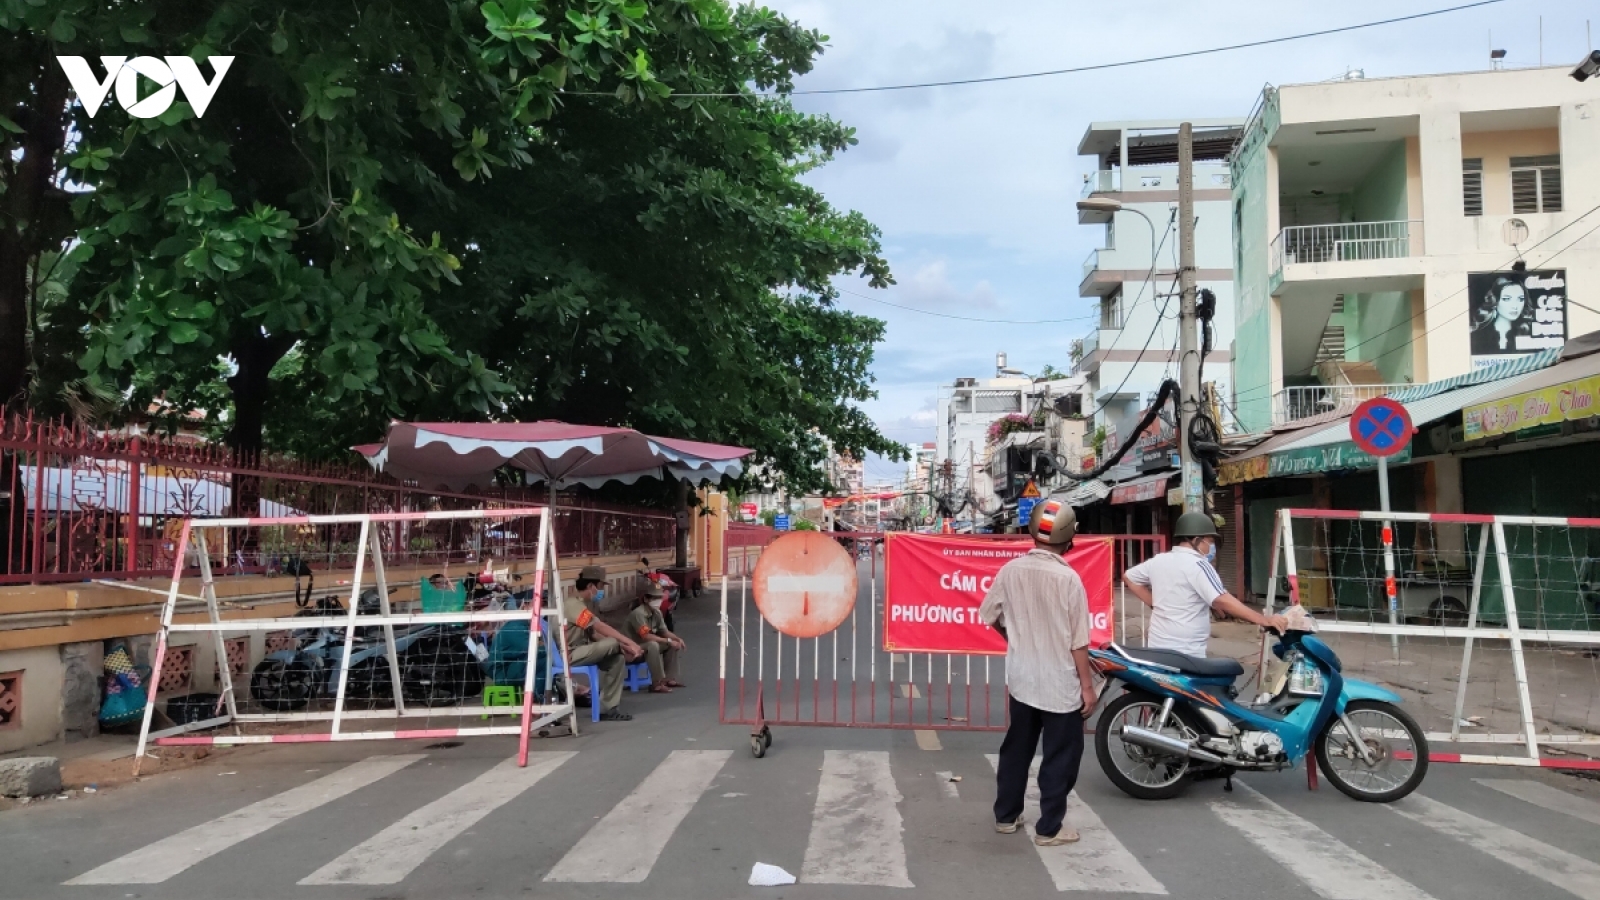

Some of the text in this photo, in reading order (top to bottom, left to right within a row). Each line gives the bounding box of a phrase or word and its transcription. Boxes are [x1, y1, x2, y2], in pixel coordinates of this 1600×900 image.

[972, 549, 994, 557] NHÂN
[940, 569, 977, 592] CẤM
[891, 602, 965, 624] PHƯƠNG
